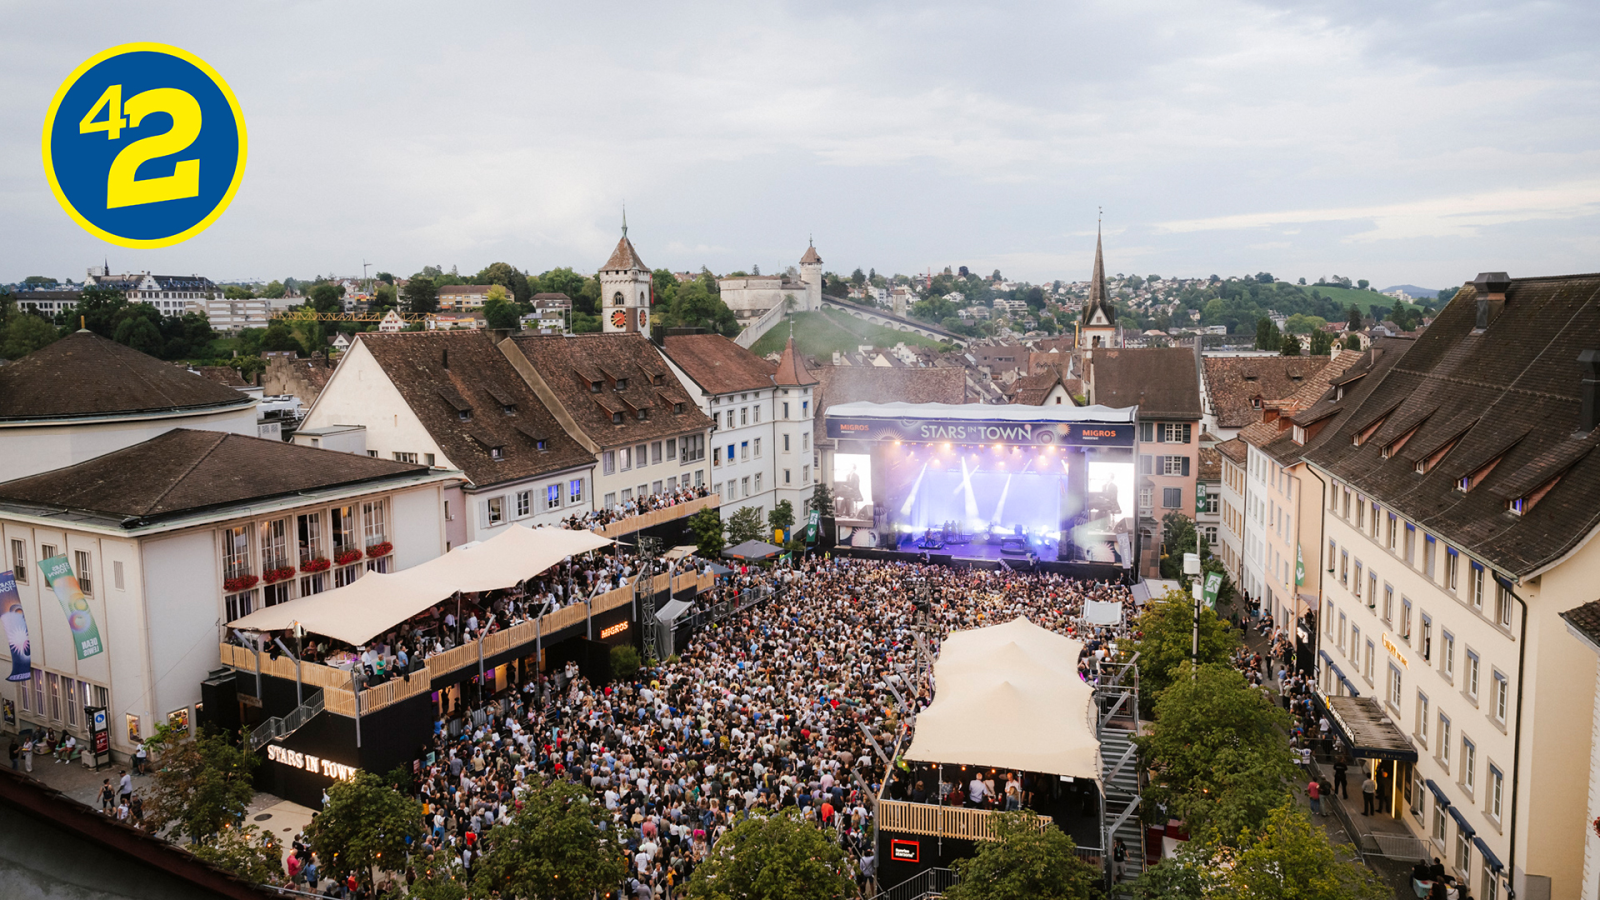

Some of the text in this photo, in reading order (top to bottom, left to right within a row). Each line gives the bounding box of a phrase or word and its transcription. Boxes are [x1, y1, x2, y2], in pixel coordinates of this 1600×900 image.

[840, 423, 869, 431] MIGROS
[920, 425, 966, 439] STARS
[978, 426, 1032, 441] TOWN
[601, 621, 628, 638] MIGROS
[267, 744, 304, 769] STARS
[304, 754, 320, 774] IN
